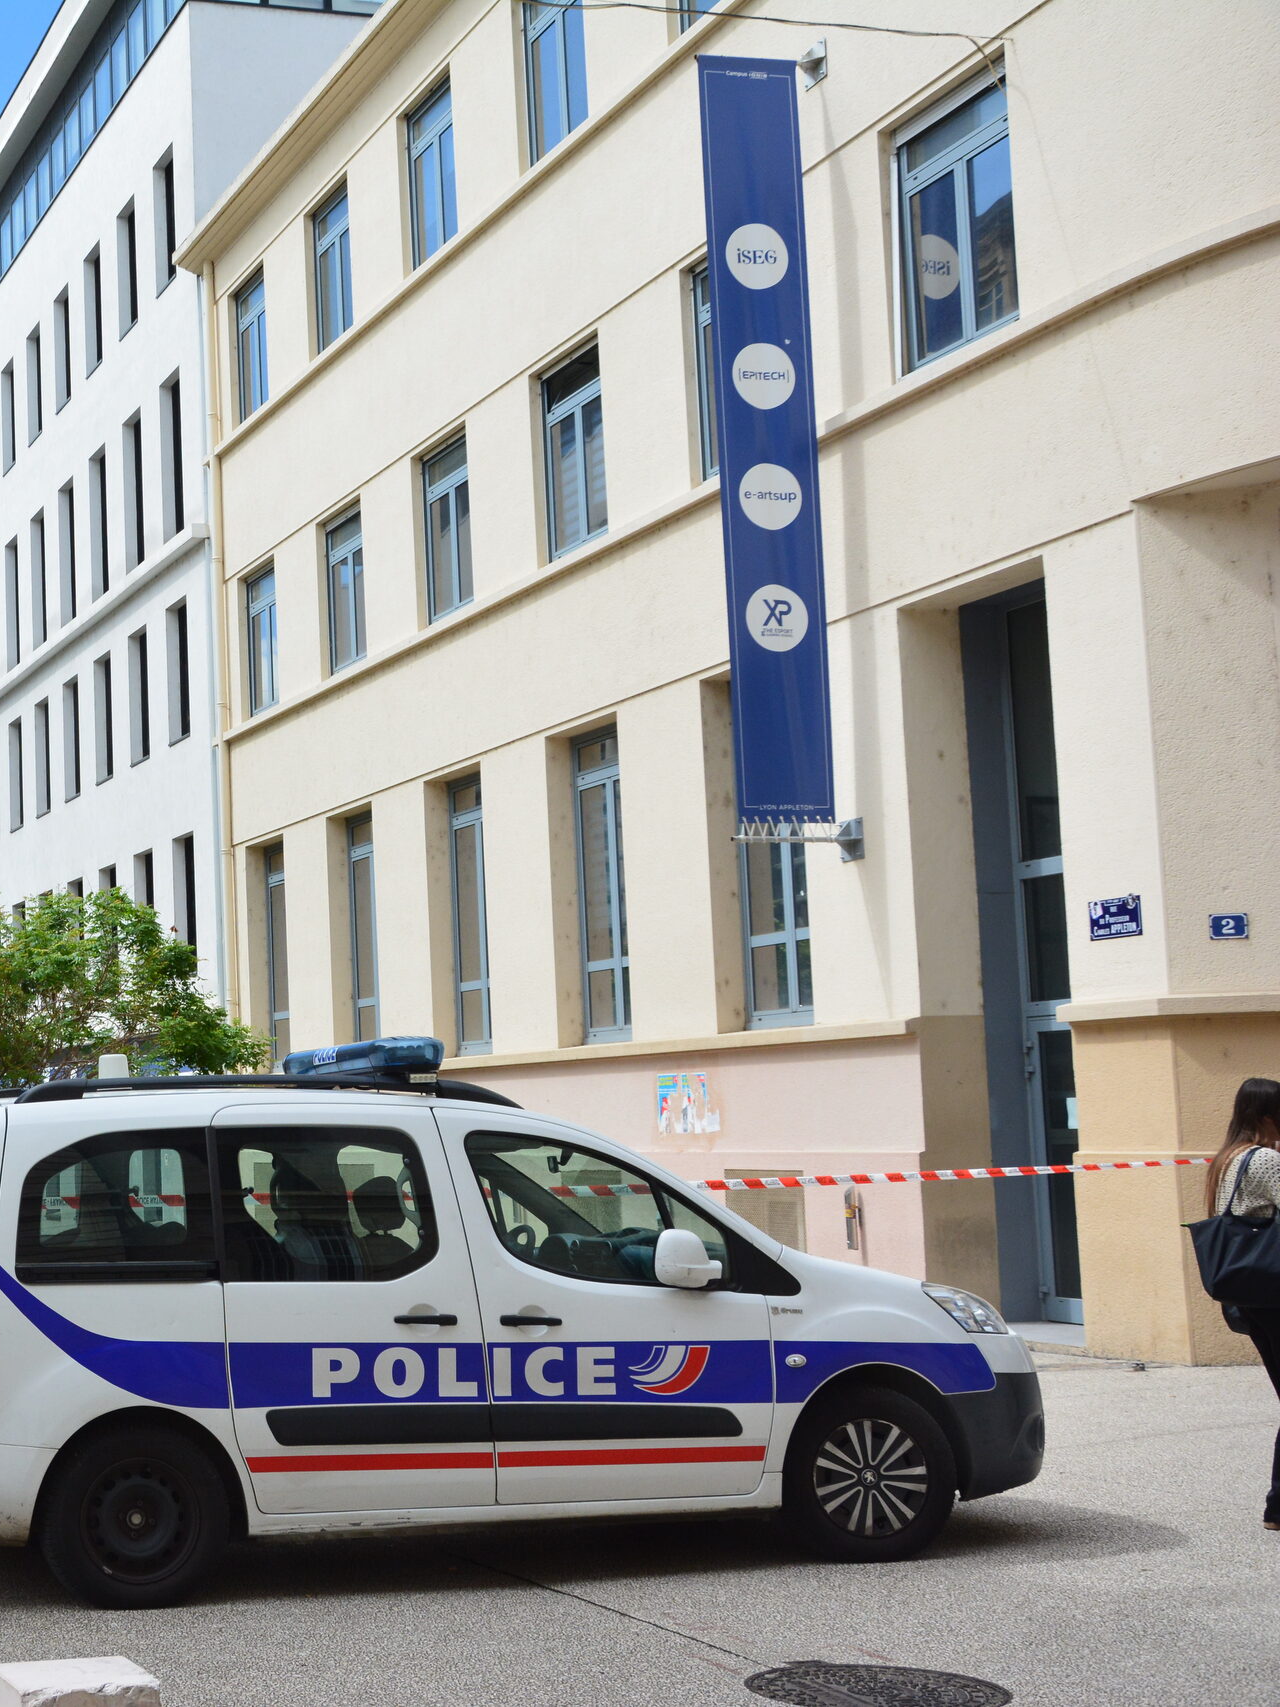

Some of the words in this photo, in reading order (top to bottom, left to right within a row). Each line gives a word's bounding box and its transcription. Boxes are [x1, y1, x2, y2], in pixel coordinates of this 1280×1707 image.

[737, 248, 777, 265] iSEG
[744, 489, 797, 503] e-artsup
[763, 599, 792, 627] XP
[1221, 919, 1236, 934] 2
[310, 1344, 617, 1400] POLICE
